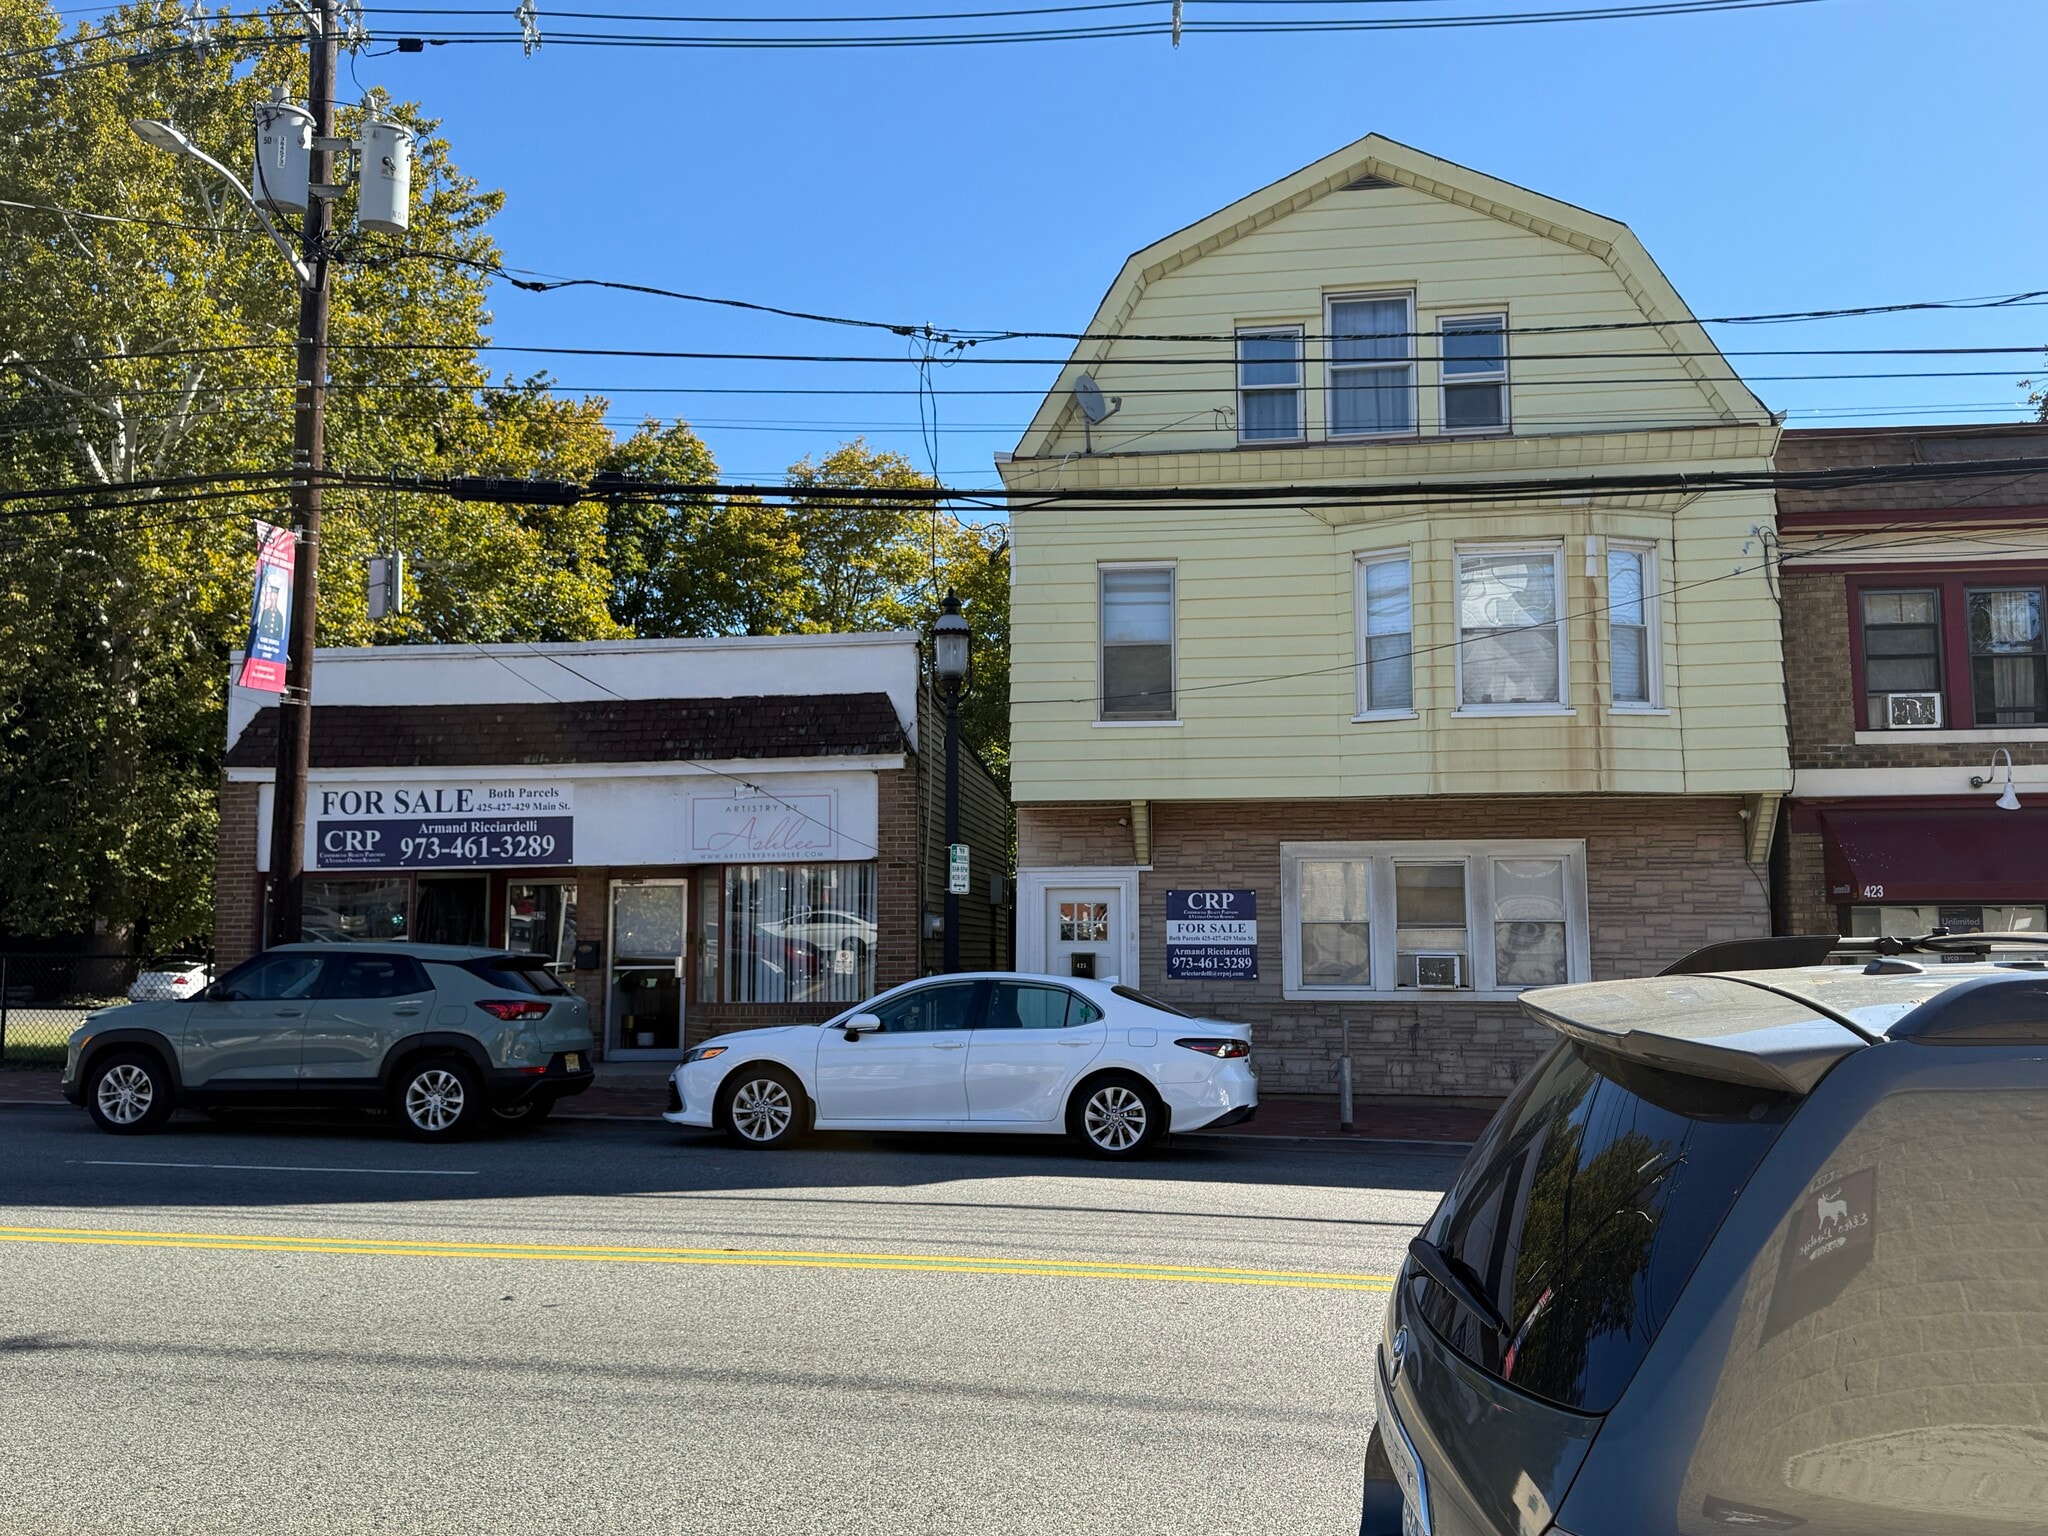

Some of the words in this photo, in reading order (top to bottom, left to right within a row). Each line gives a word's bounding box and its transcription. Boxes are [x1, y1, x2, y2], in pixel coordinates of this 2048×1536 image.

[264, 136, 272, 145] 50
[488, 788, 515, 799] Both
[518, 787, 560, 798] Parcels
[321, 790, 385, 815] FOR
[394, 788, 474, 815] SALE
[476, 802, 530, 812] 425-427-429
[532, 802, 556, 811] Main
[558, 802, 571, 811] St.
[725, 804, 779, 813] ARTISTRY
[786, 804, 798, 812] BY
[418, 822, 467, 834] Armand
[470, 820, 538, 833] Ricciardelli
[707, 816, 814, 852] Ashlee
[324, 830, 381, 852] CRP
[400, 834, 555, 860] 973-461-3289
[700, 851, 824, 860] WWW.ARTISTRYBYASHLEE.COM
[1864, 885, 1884, 898] 423
[1187, 892, 1235, 910] CRP
[1942, 917, 1980, 926] Unlimited
[1177, 923, 1206, 934] FOR
[1210, 923, 1247, 934] SALE
[1174, 948, 1205, 956] Armand
[1207, 947, 1250, 956] Ricciardelli
[1172, 957, 1252, 969] 973-461-3289
